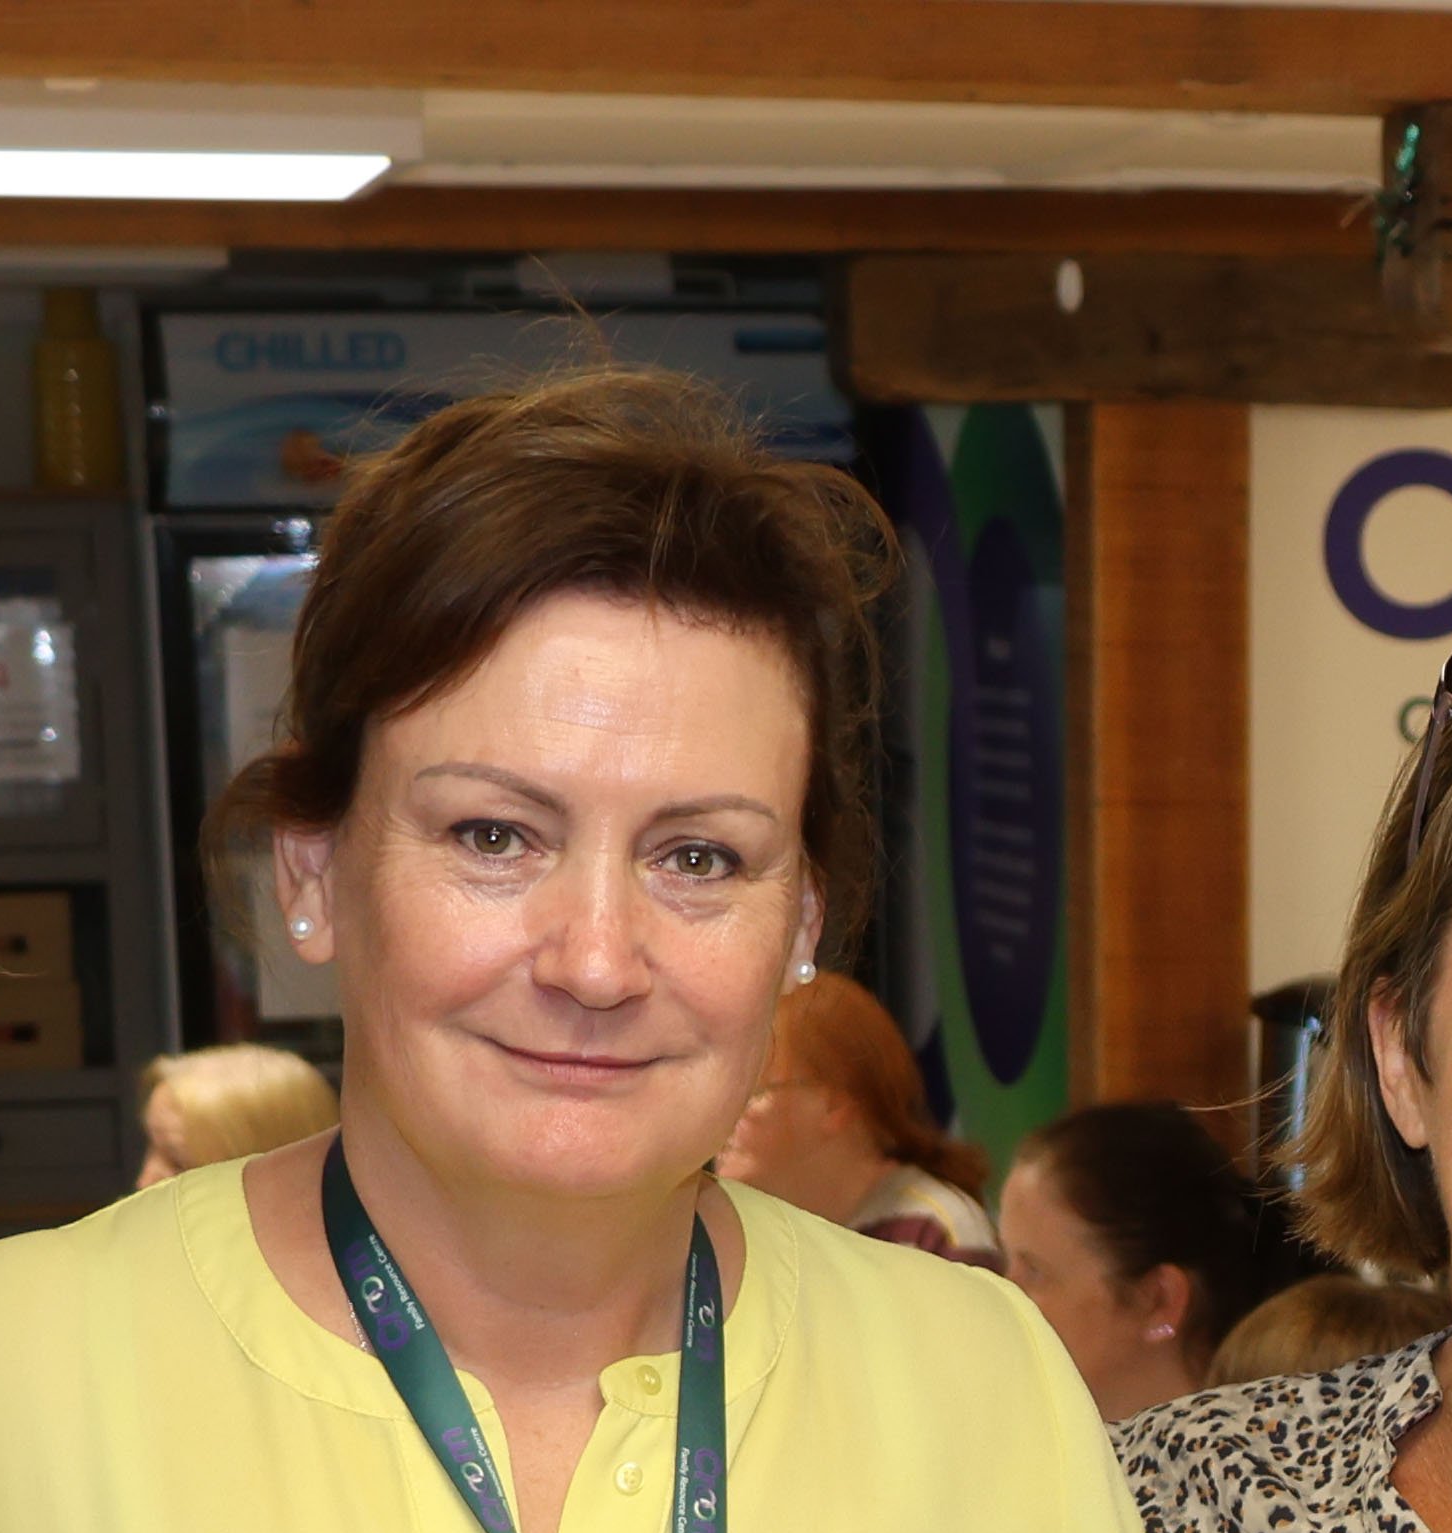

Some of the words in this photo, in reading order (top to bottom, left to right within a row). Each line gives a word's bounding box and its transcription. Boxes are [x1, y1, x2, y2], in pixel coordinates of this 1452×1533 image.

[215, 331, 406, 372] CHILLED
[368, 1233, 388, 1264] Centre
[344, 1240, 410, 1349] Croom
[384, 1263, 410, 1303] Resource
[405, 1301, 426, 1330] Family
[679, 1447, 690, 1476] Family
[678, 1476, 689, 1516] Resource
